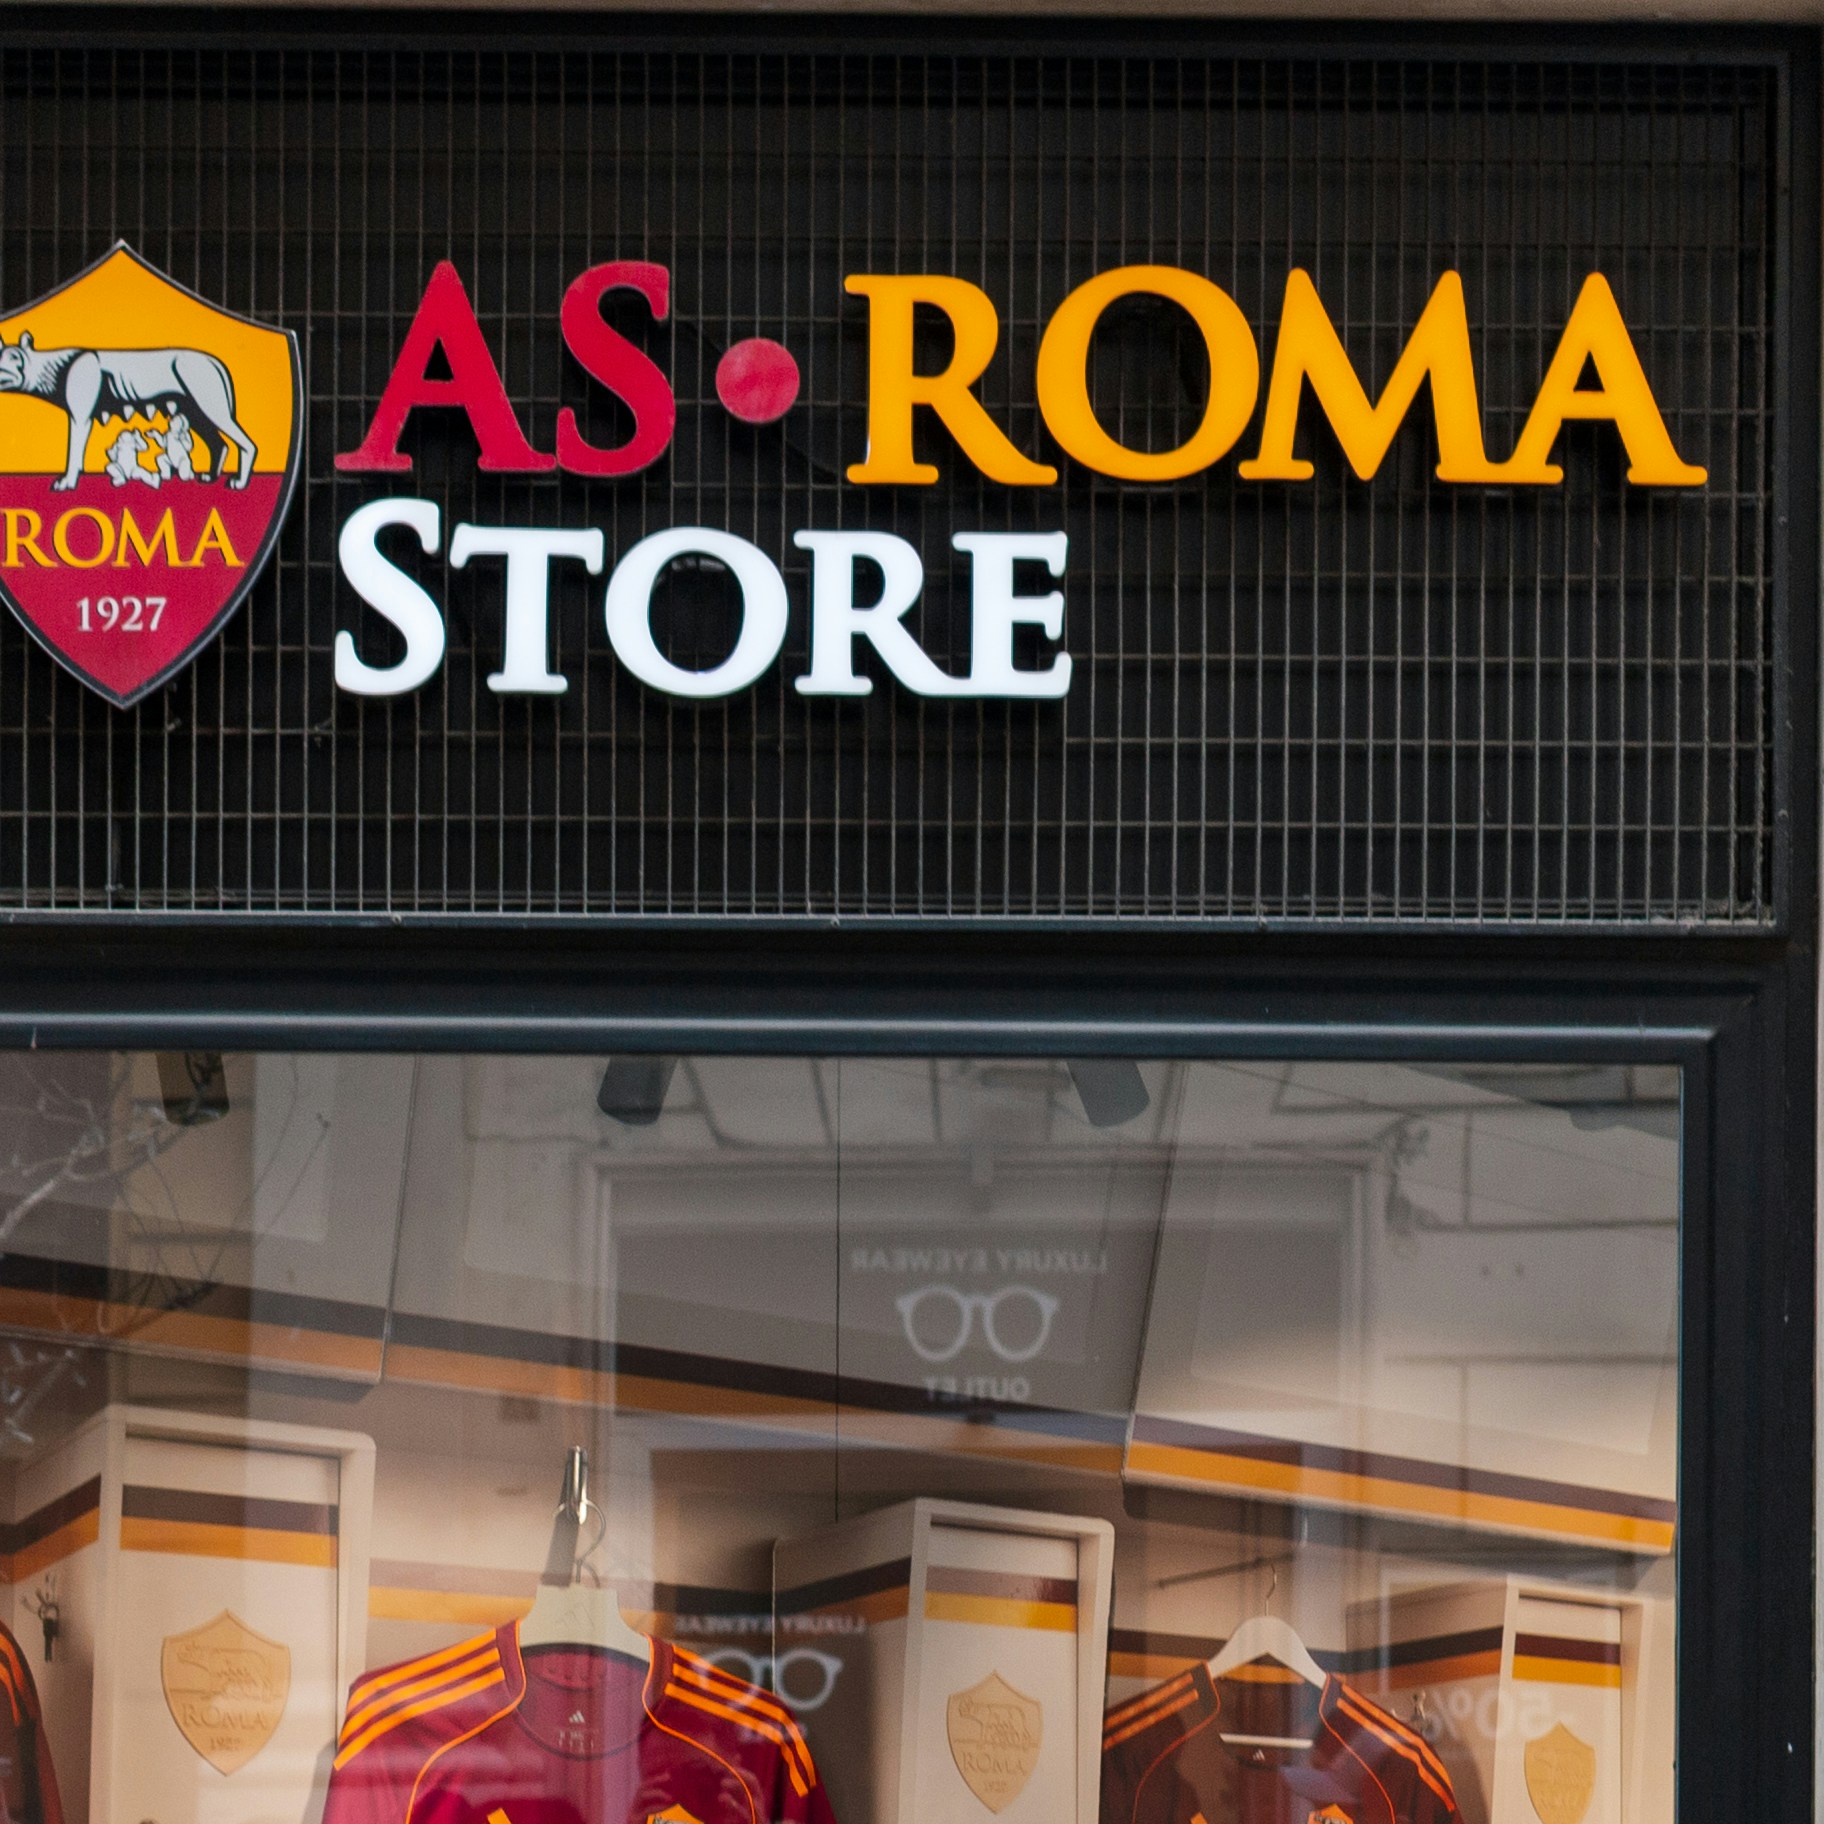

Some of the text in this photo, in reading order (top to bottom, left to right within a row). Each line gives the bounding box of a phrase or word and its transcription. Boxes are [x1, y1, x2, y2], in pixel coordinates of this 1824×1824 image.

[334, 260, 1708, 485] AS ROMA
[0, 507, 245, 568] ROMA
[335, 498, 1072, 696] STORE
[77, 596, 167, 632] 1927
